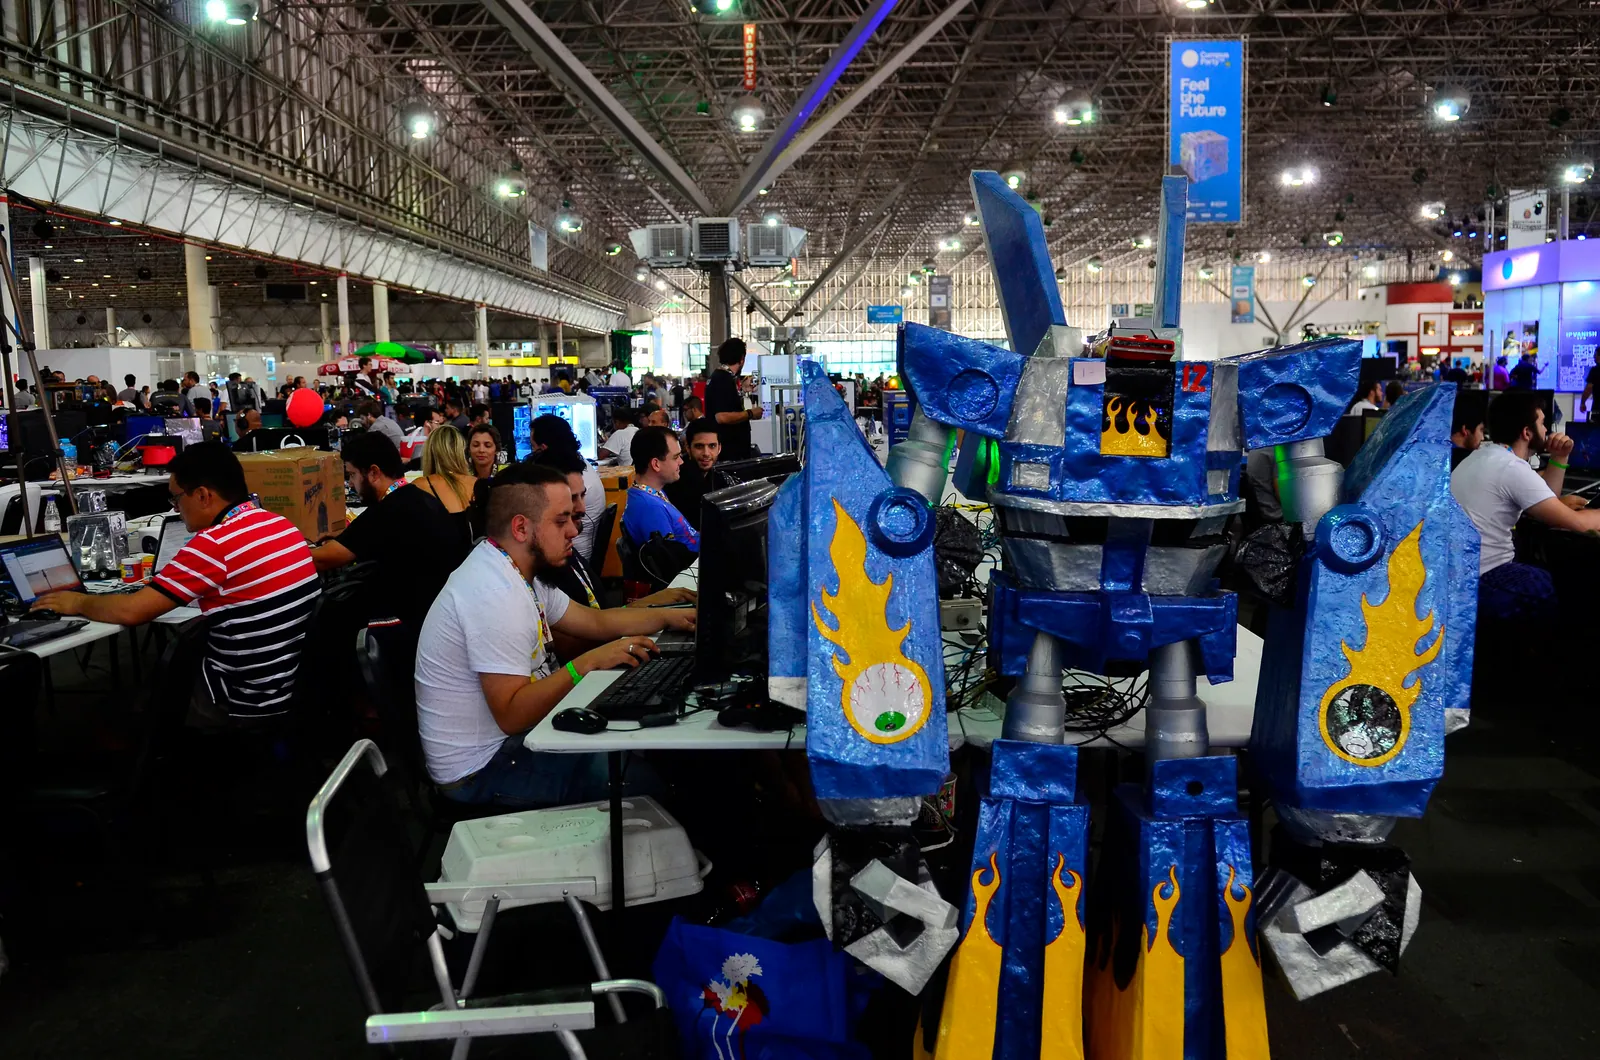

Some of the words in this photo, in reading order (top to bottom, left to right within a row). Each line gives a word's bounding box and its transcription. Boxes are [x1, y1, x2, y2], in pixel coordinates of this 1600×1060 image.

[745, 27, 754, 86] HIDRANTE
[1180, 77, 1209, 91] Feel
[1180, 91, 1205, 104] the
[1180, 104, 1226, 117] Future
